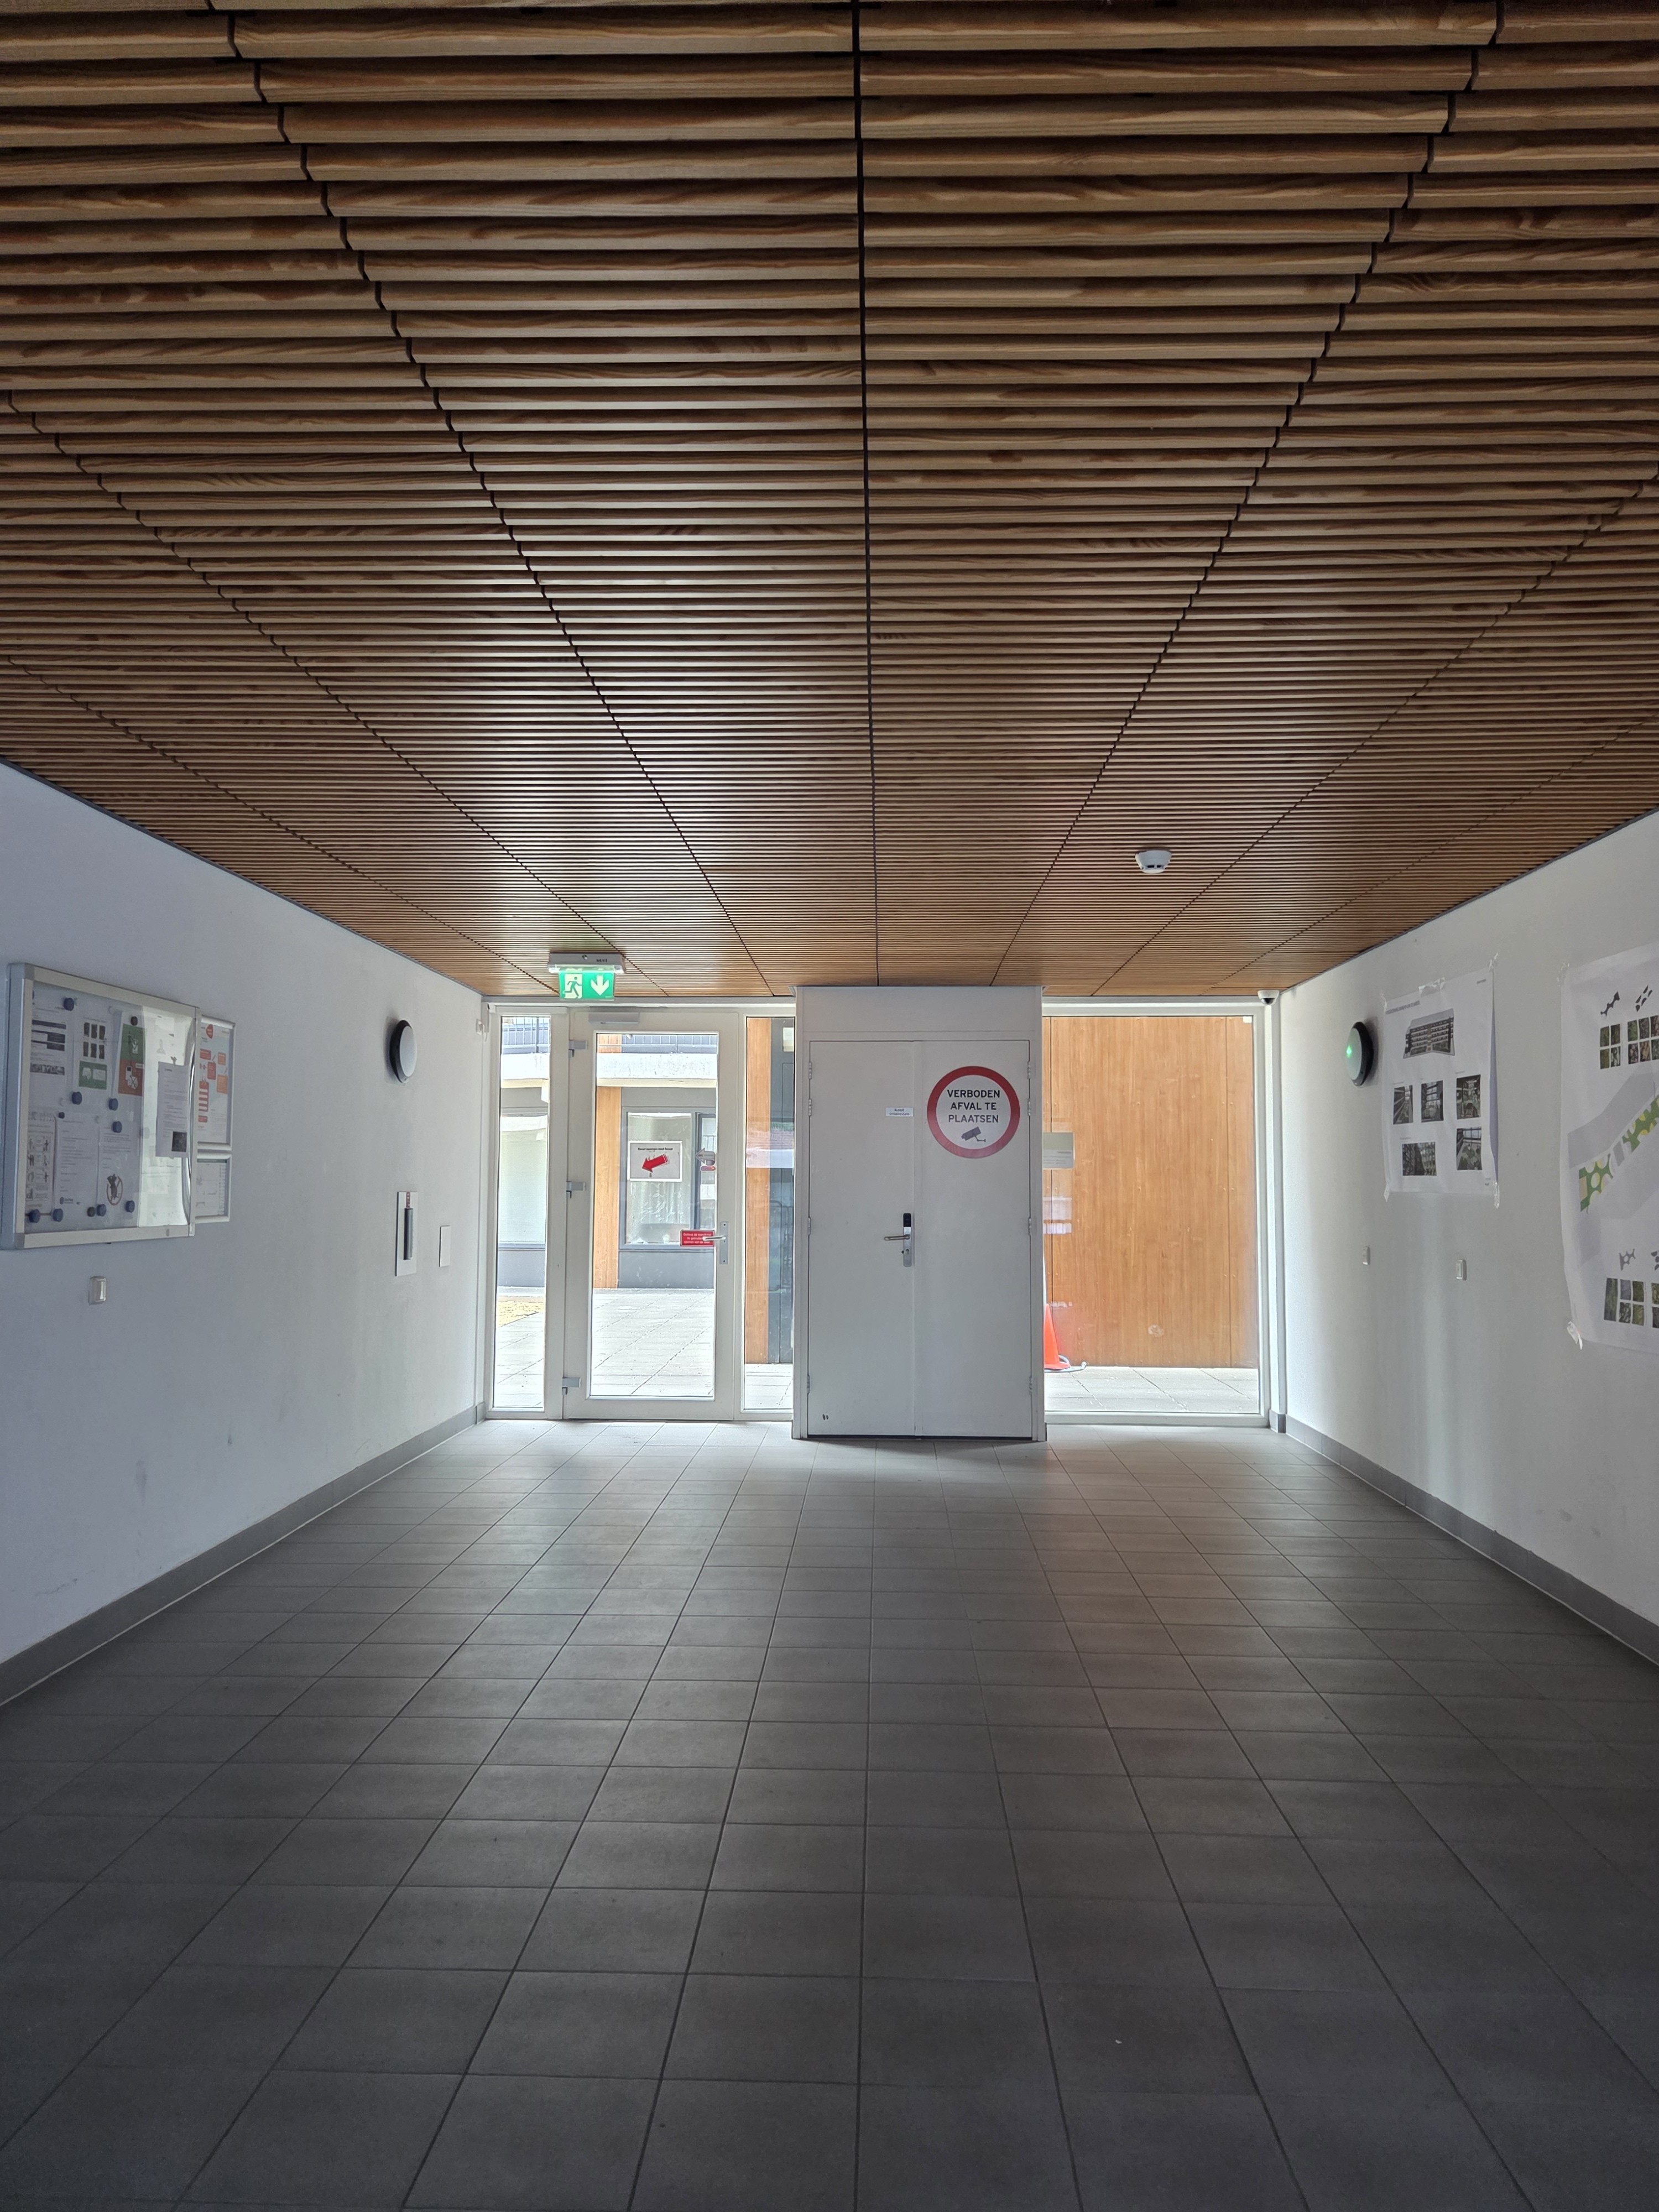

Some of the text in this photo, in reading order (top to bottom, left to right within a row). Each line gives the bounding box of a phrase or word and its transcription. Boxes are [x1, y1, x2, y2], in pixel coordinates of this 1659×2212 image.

[947, 1089, 1000, 1098] VERBODEN
[950, 1102, 997, 1110] AFVAL TE
[948, 1114, 999, 1123] PLAATSEN
